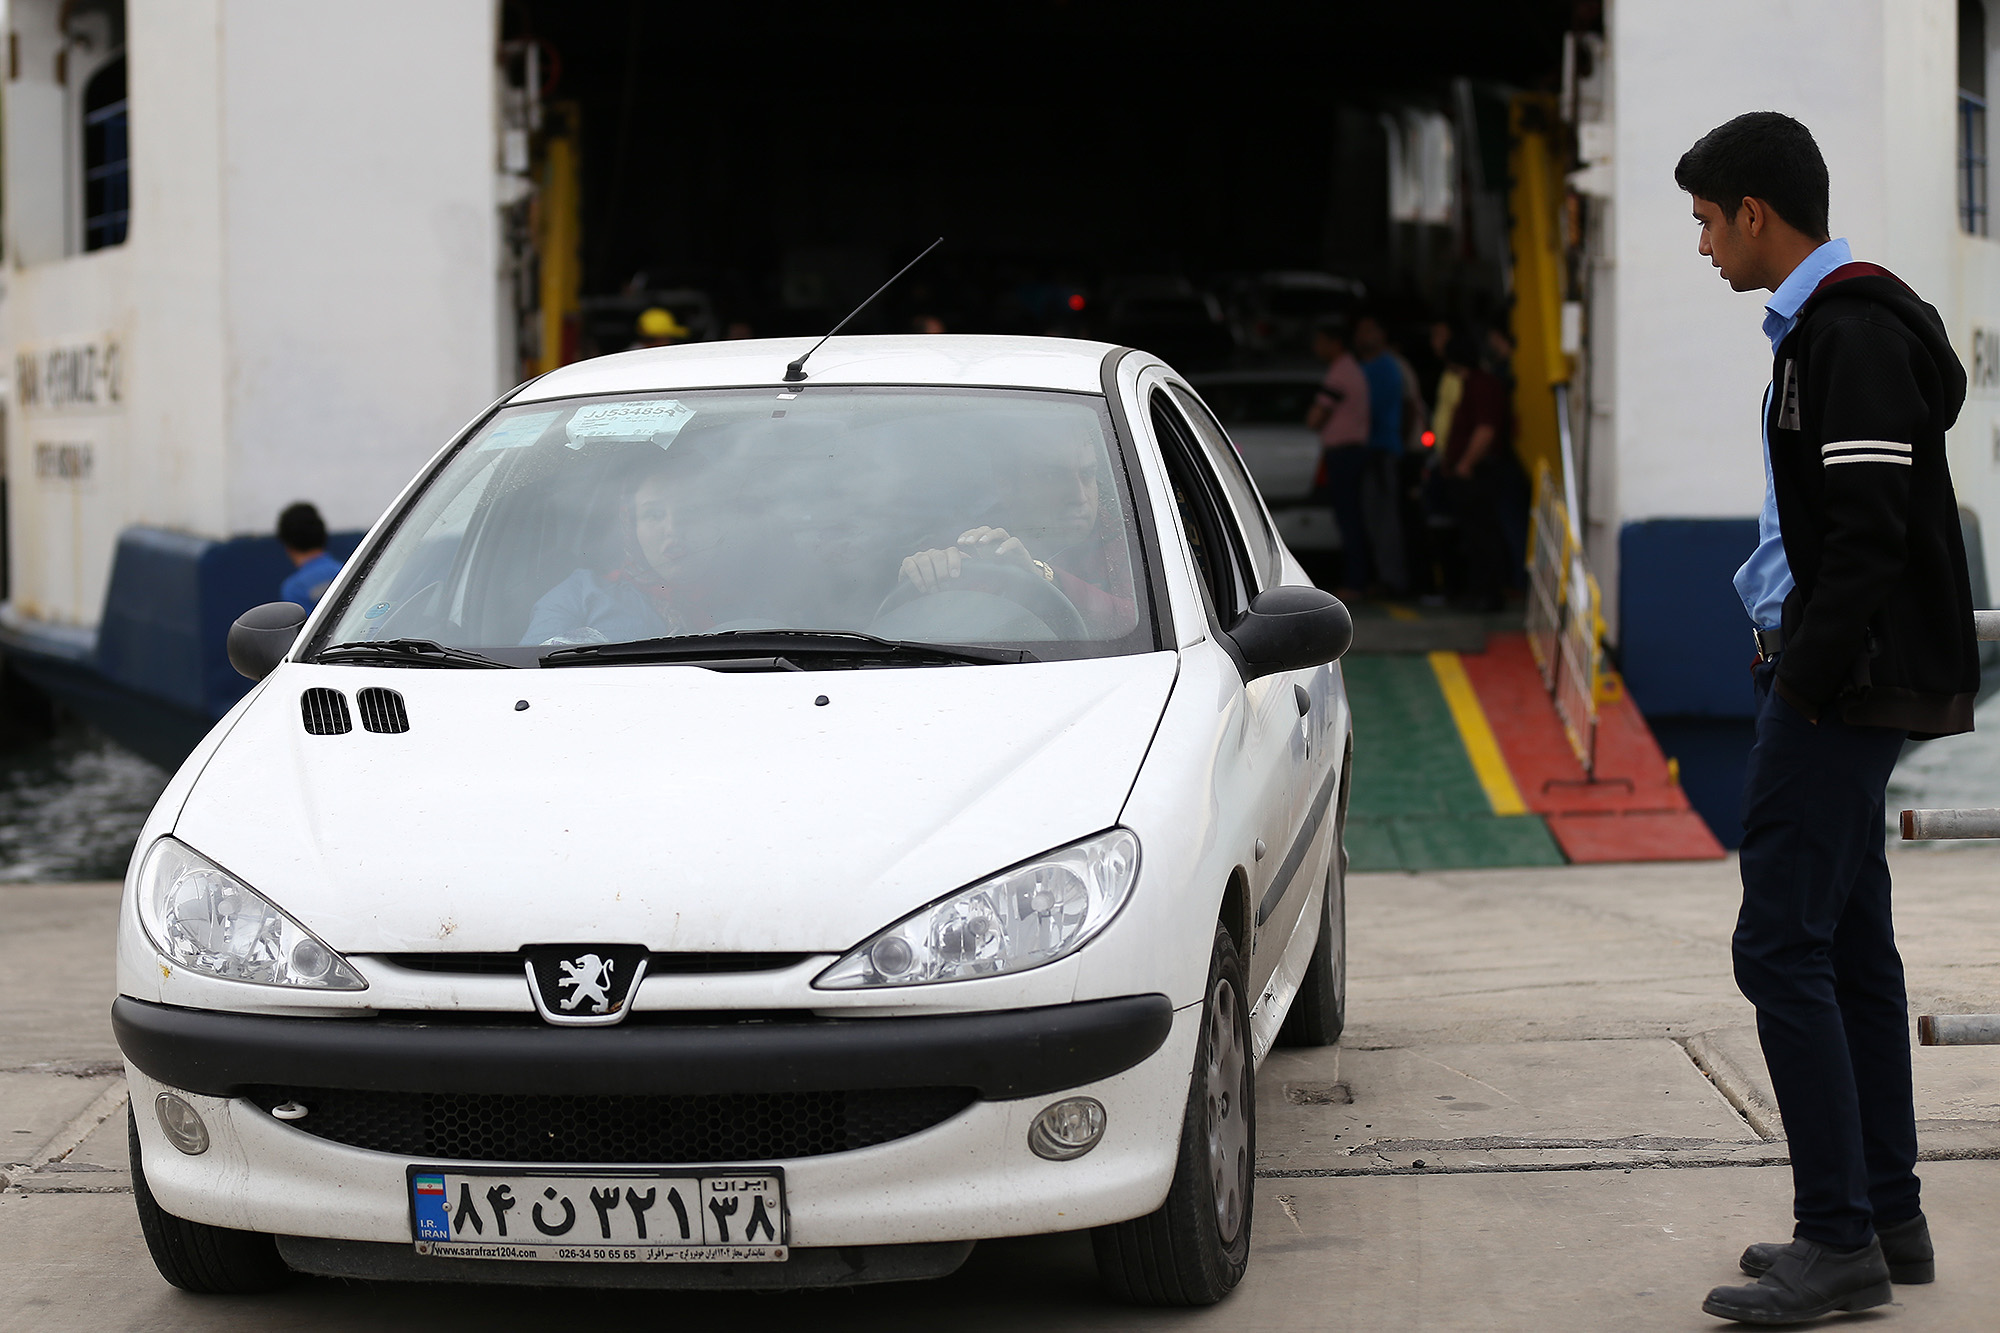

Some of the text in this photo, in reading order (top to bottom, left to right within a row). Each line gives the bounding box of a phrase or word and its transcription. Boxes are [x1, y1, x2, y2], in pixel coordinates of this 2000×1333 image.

[712, 1179, 768, 1192] ایران
[420, 1219, 438, 1229] I.R.
[708, 1195, 775, 1242] ۳۸
[421, 1229, 448, 1239] IRAN
[434, 1245, 537, 1259] www.sarafraz1204.com
[558, 1249, 592, 1259] 026-34
[609, 1249, 622, 1259] 65
[623, 1250, 636, 1260] 65
